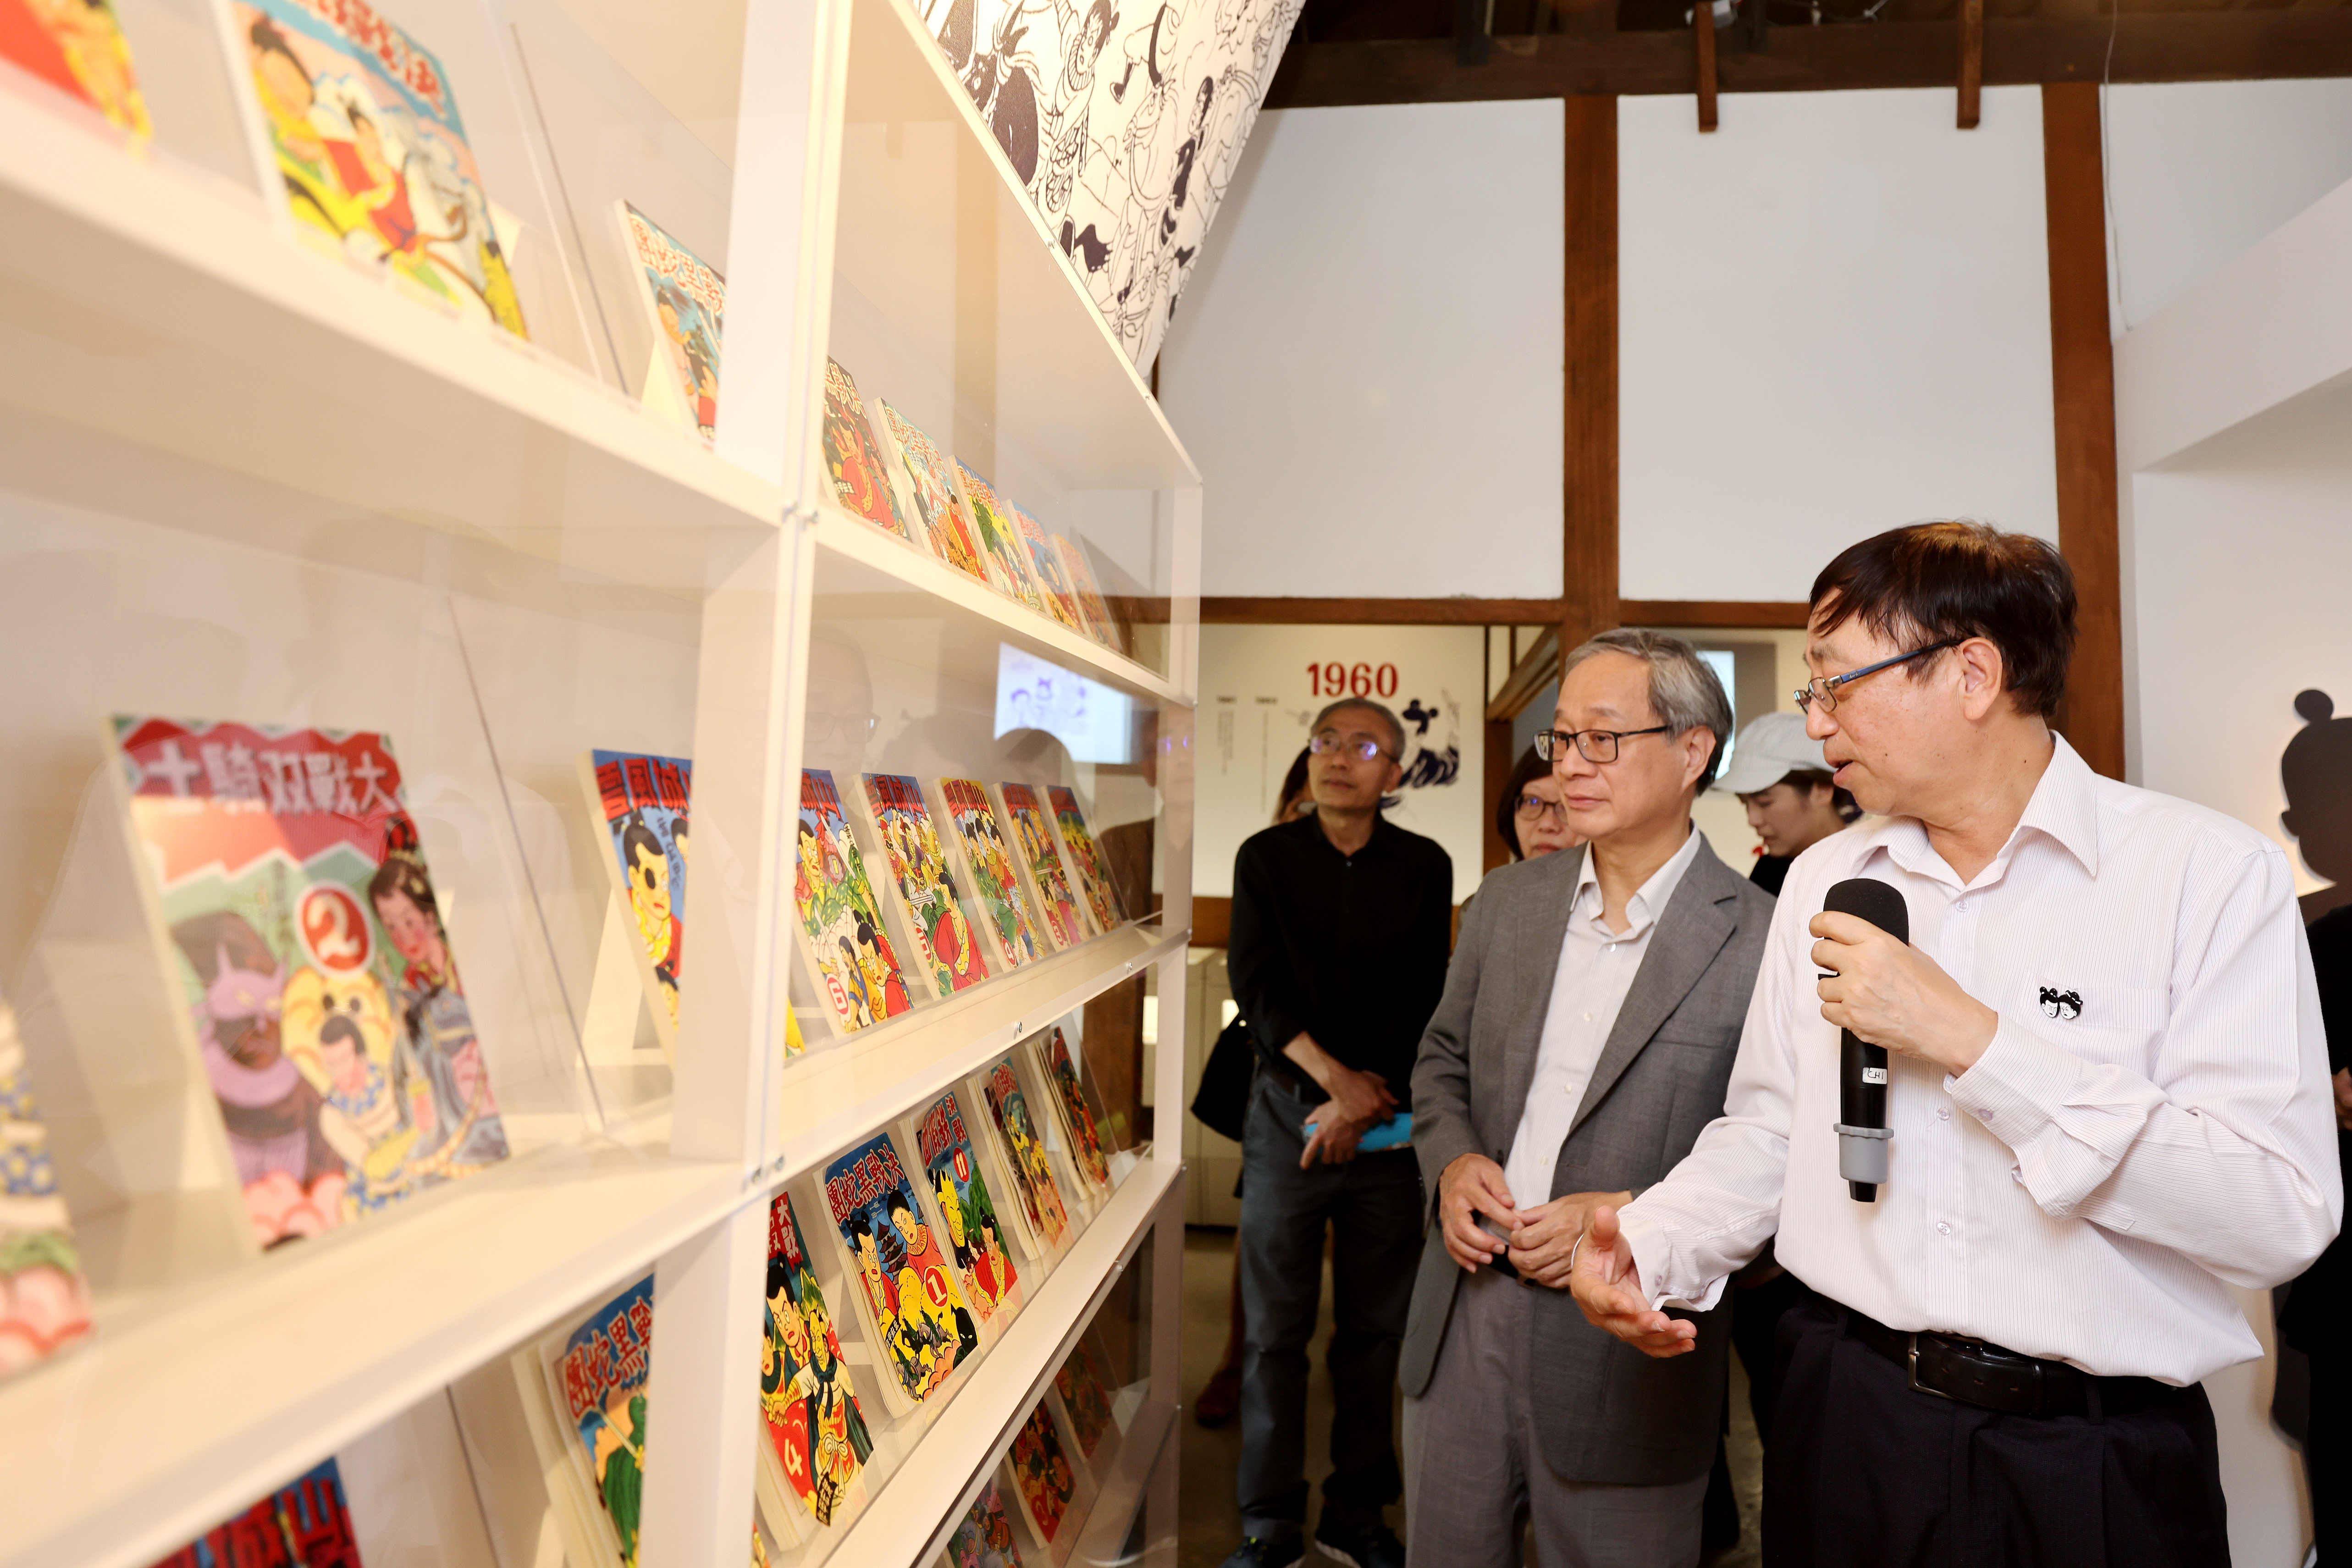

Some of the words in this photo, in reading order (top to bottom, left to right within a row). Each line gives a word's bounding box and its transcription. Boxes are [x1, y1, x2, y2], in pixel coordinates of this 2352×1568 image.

[1307, 662, 1398, 698] 1960
[306, 892, 361, 960] 2
[1004, 944, 1015, 961] 4
[830, 986, 848, 1010] 6
[955, 1152, 967, 1179] 11
[826, 1143, 905, 1226] 決戰黑蛇團
[928, 1273, 948, 1304] 1
[784, 1443, 802, 1477] 4
